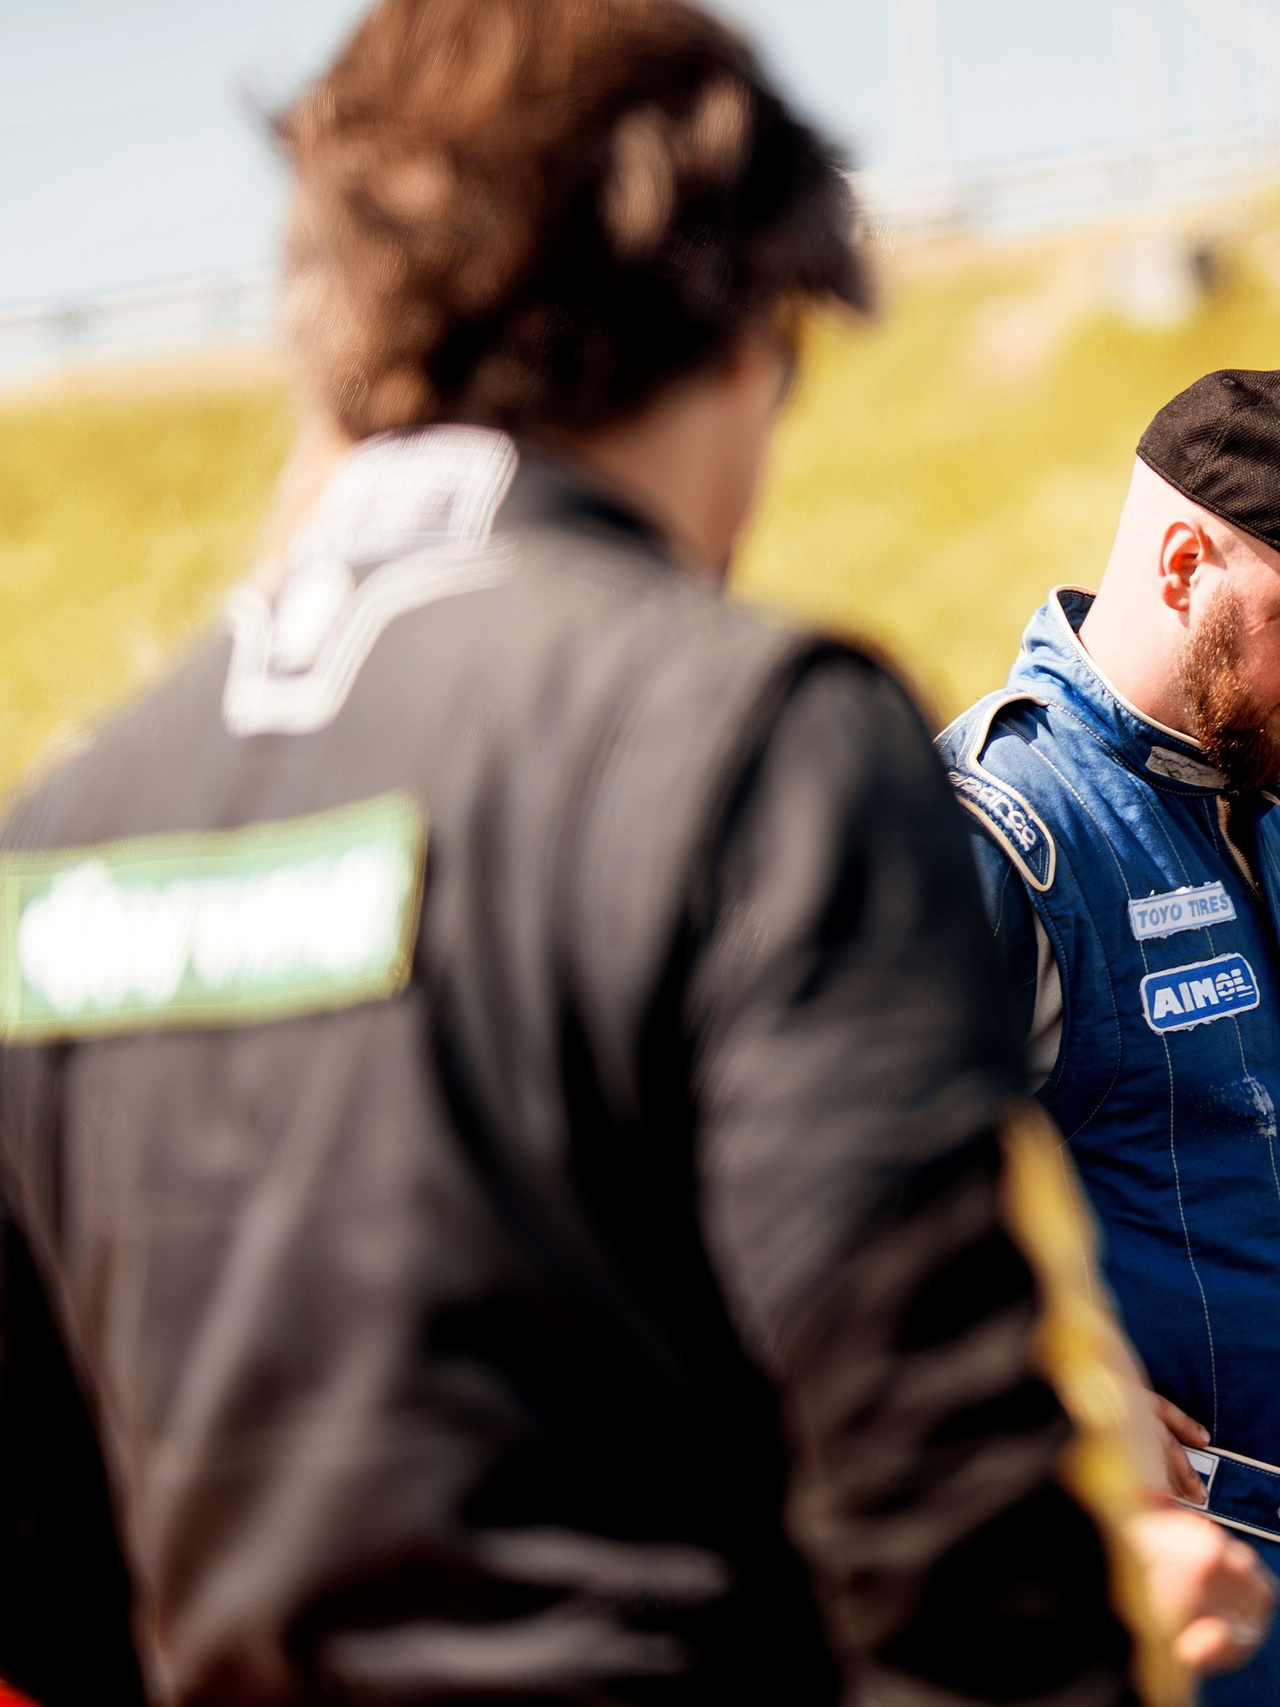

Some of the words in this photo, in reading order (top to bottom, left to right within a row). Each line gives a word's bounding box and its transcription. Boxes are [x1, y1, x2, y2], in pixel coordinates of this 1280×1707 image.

[1137, 902, 1183, 929] TOYO
[1188, 893, 1232, 918] TIRES
[1153, 968, 1255, 1020] AIMOL
